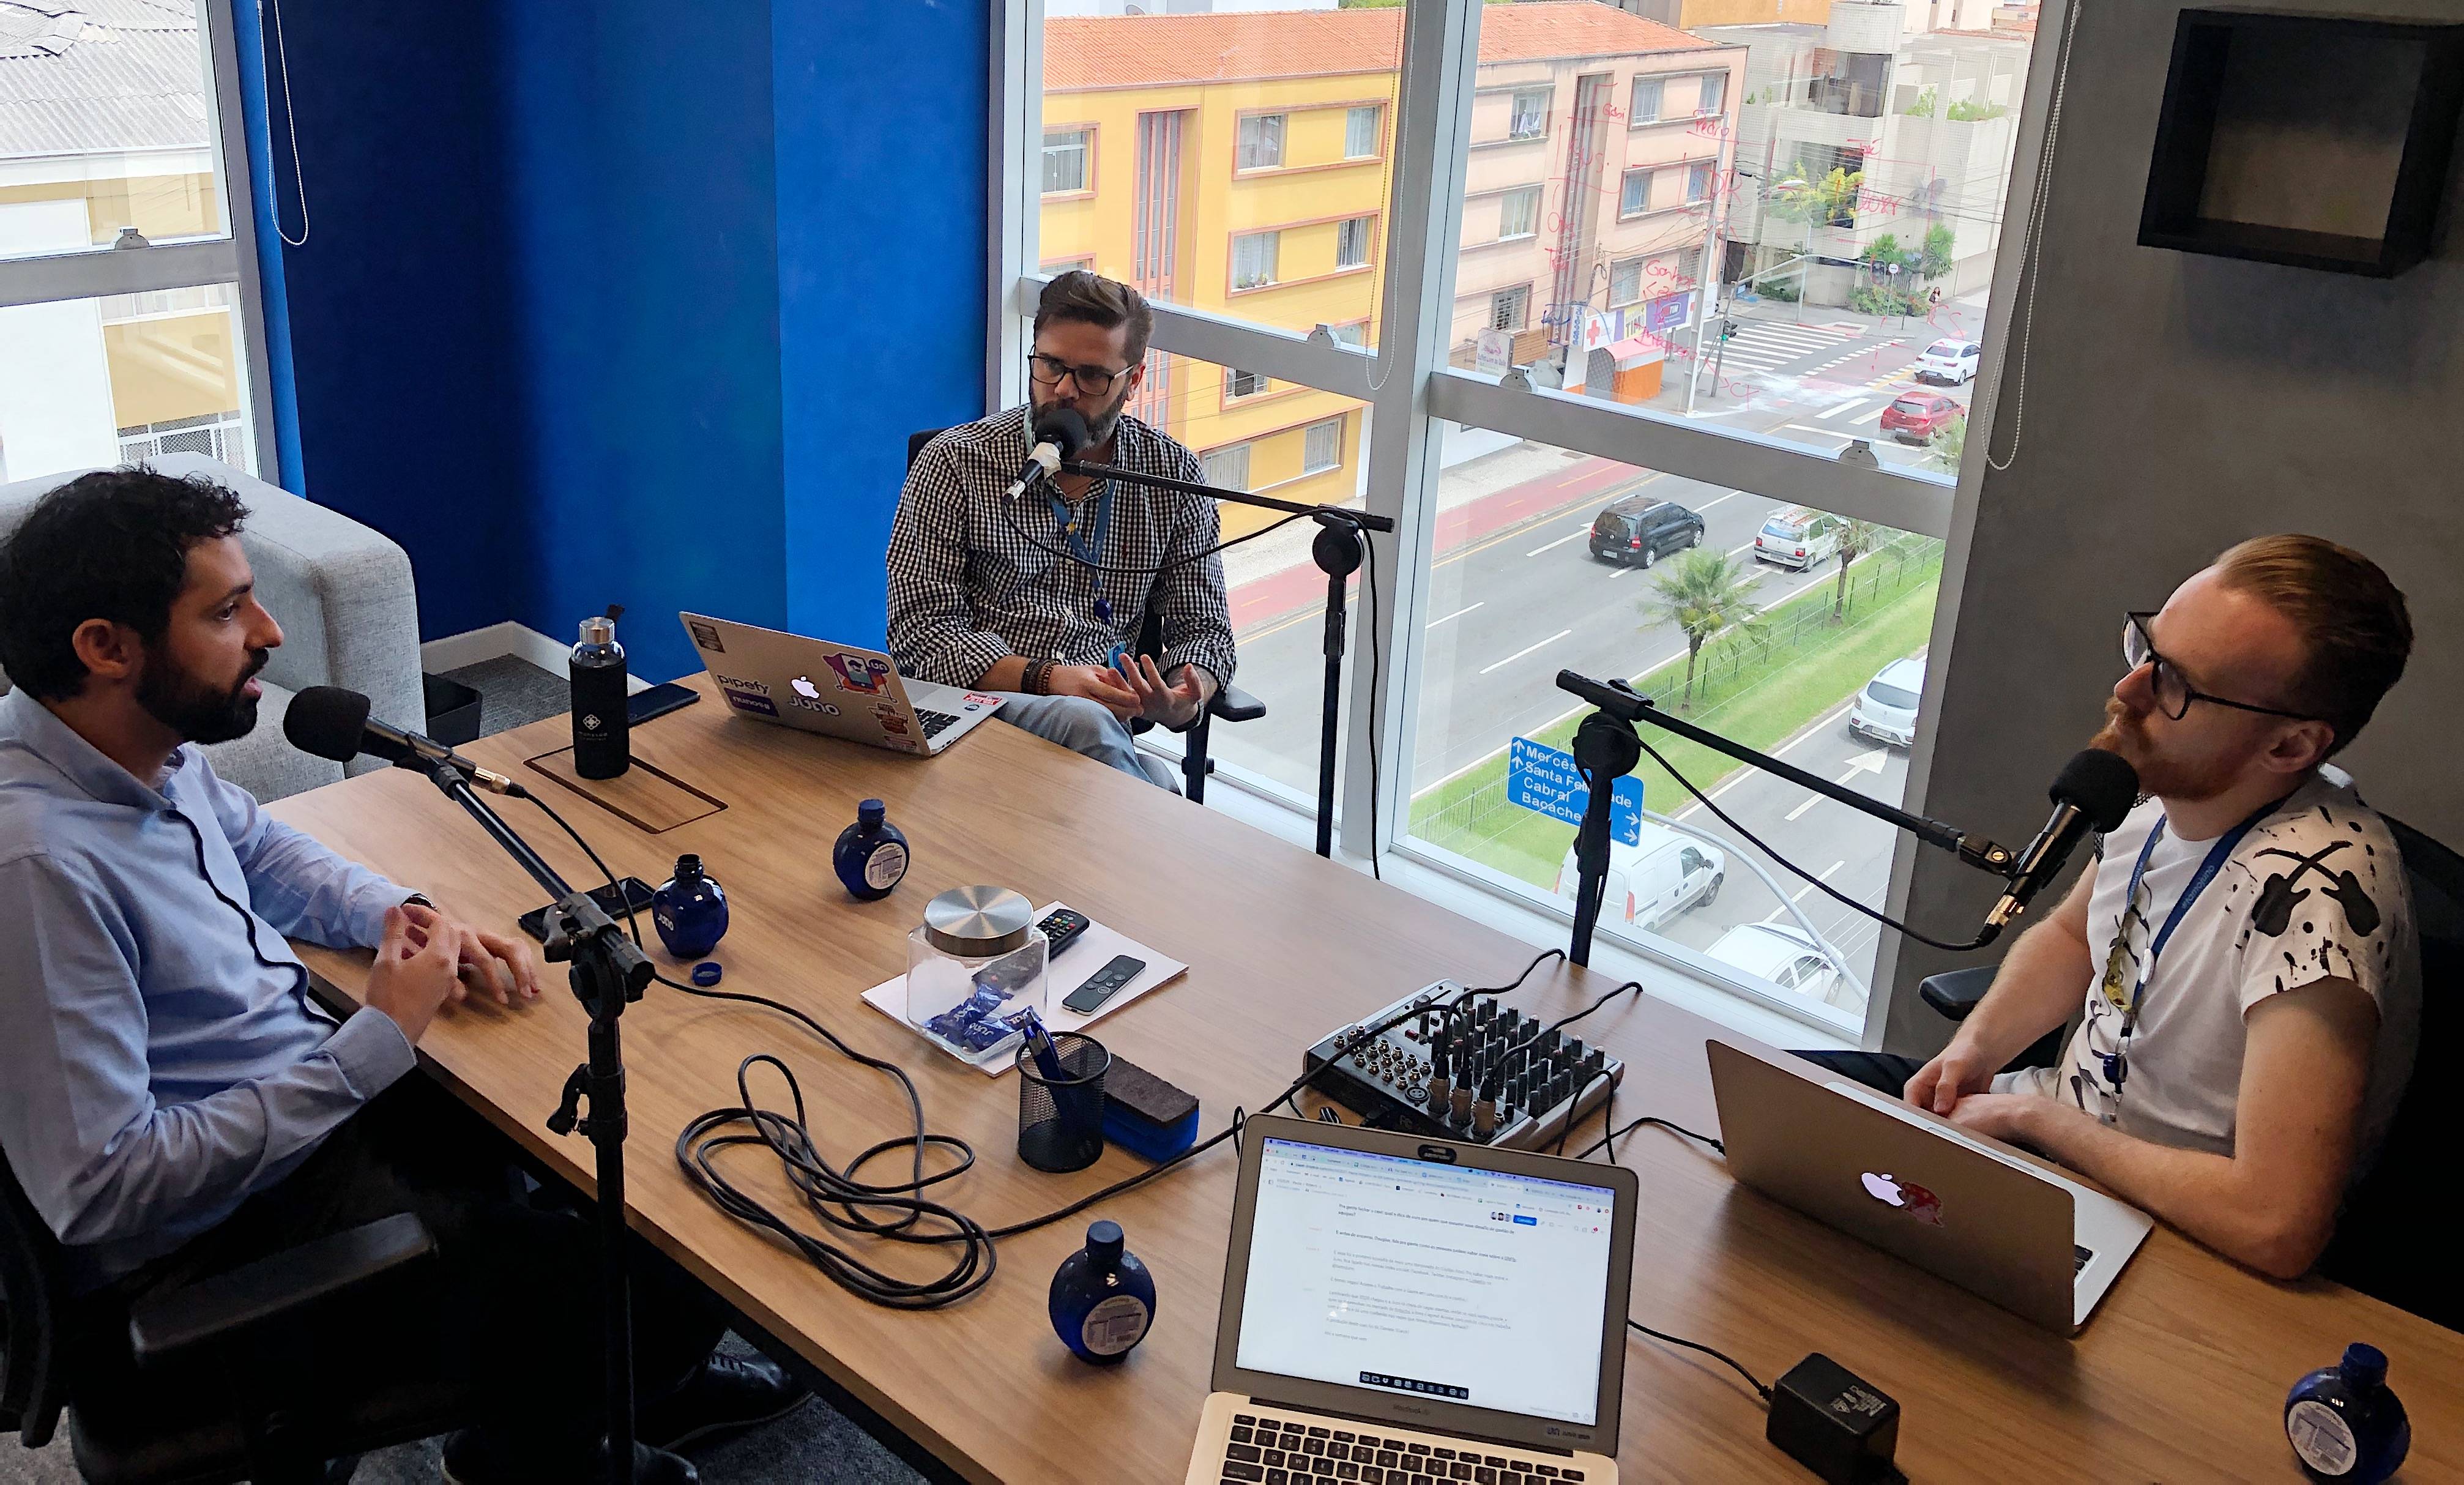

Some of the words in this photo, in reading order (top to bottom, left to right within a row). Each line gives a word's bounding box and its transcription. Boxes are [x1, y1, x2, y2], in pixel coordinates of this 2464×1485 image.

[716, 675, 769, 694] pipefy
[1526, 745, 1577, 773] Mercês
[1523, 777, 1570, 803] Cabral
[1525, 761, 1563, 784] Santa
[1566, 775, 1632, 808] Felide
[1522, 791, 1582, 822] Bacache
